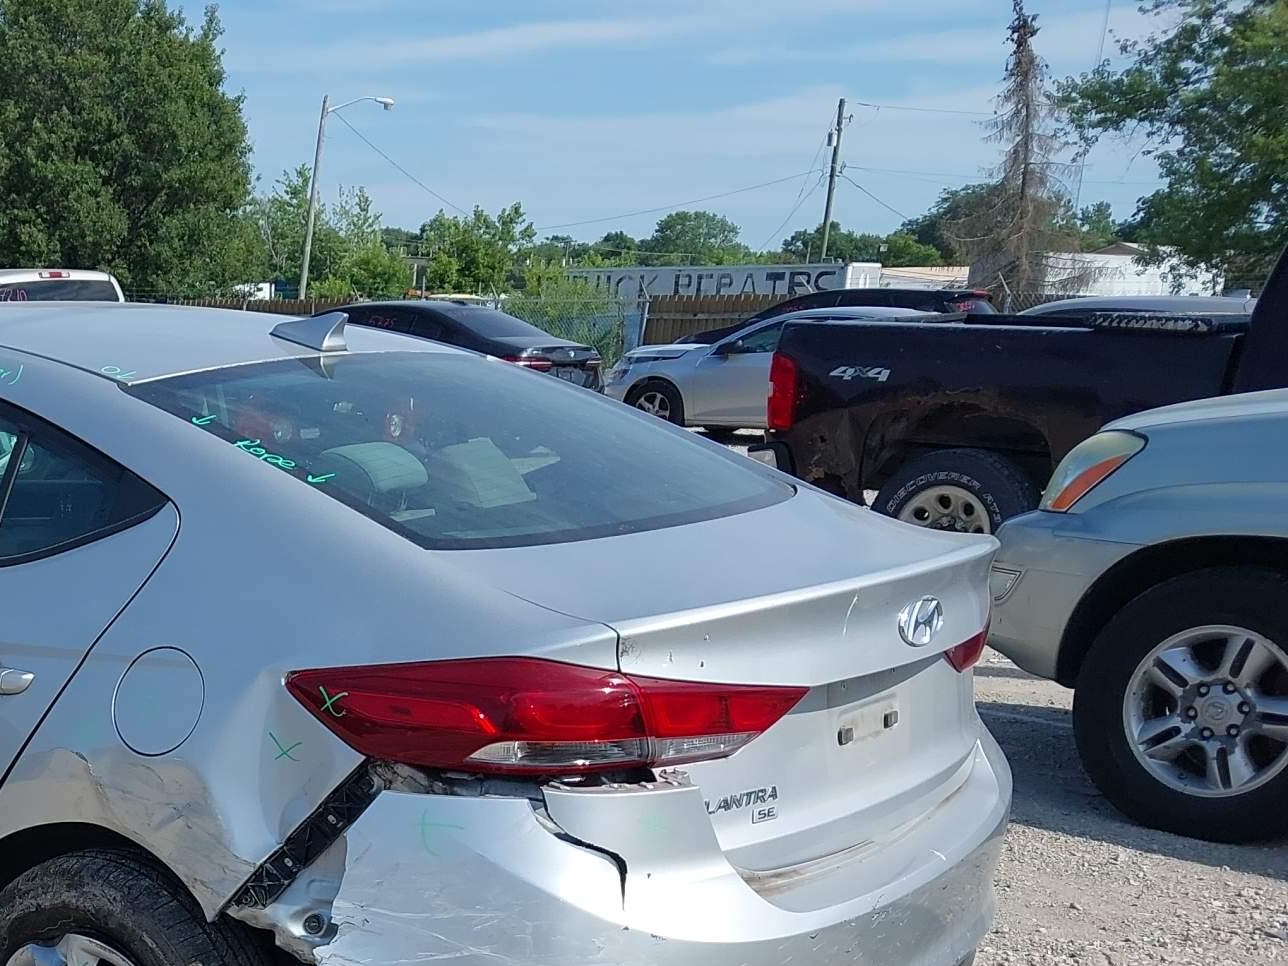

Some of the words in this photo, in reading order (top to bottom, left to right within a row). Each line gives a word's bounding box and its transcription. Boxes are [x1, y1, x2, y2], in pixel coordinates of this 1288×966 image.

[886, 471, 982, 513] DISCOVERER
[704, 785, 778, 815] LANTRA
[757, 807, 776, 820] SE
